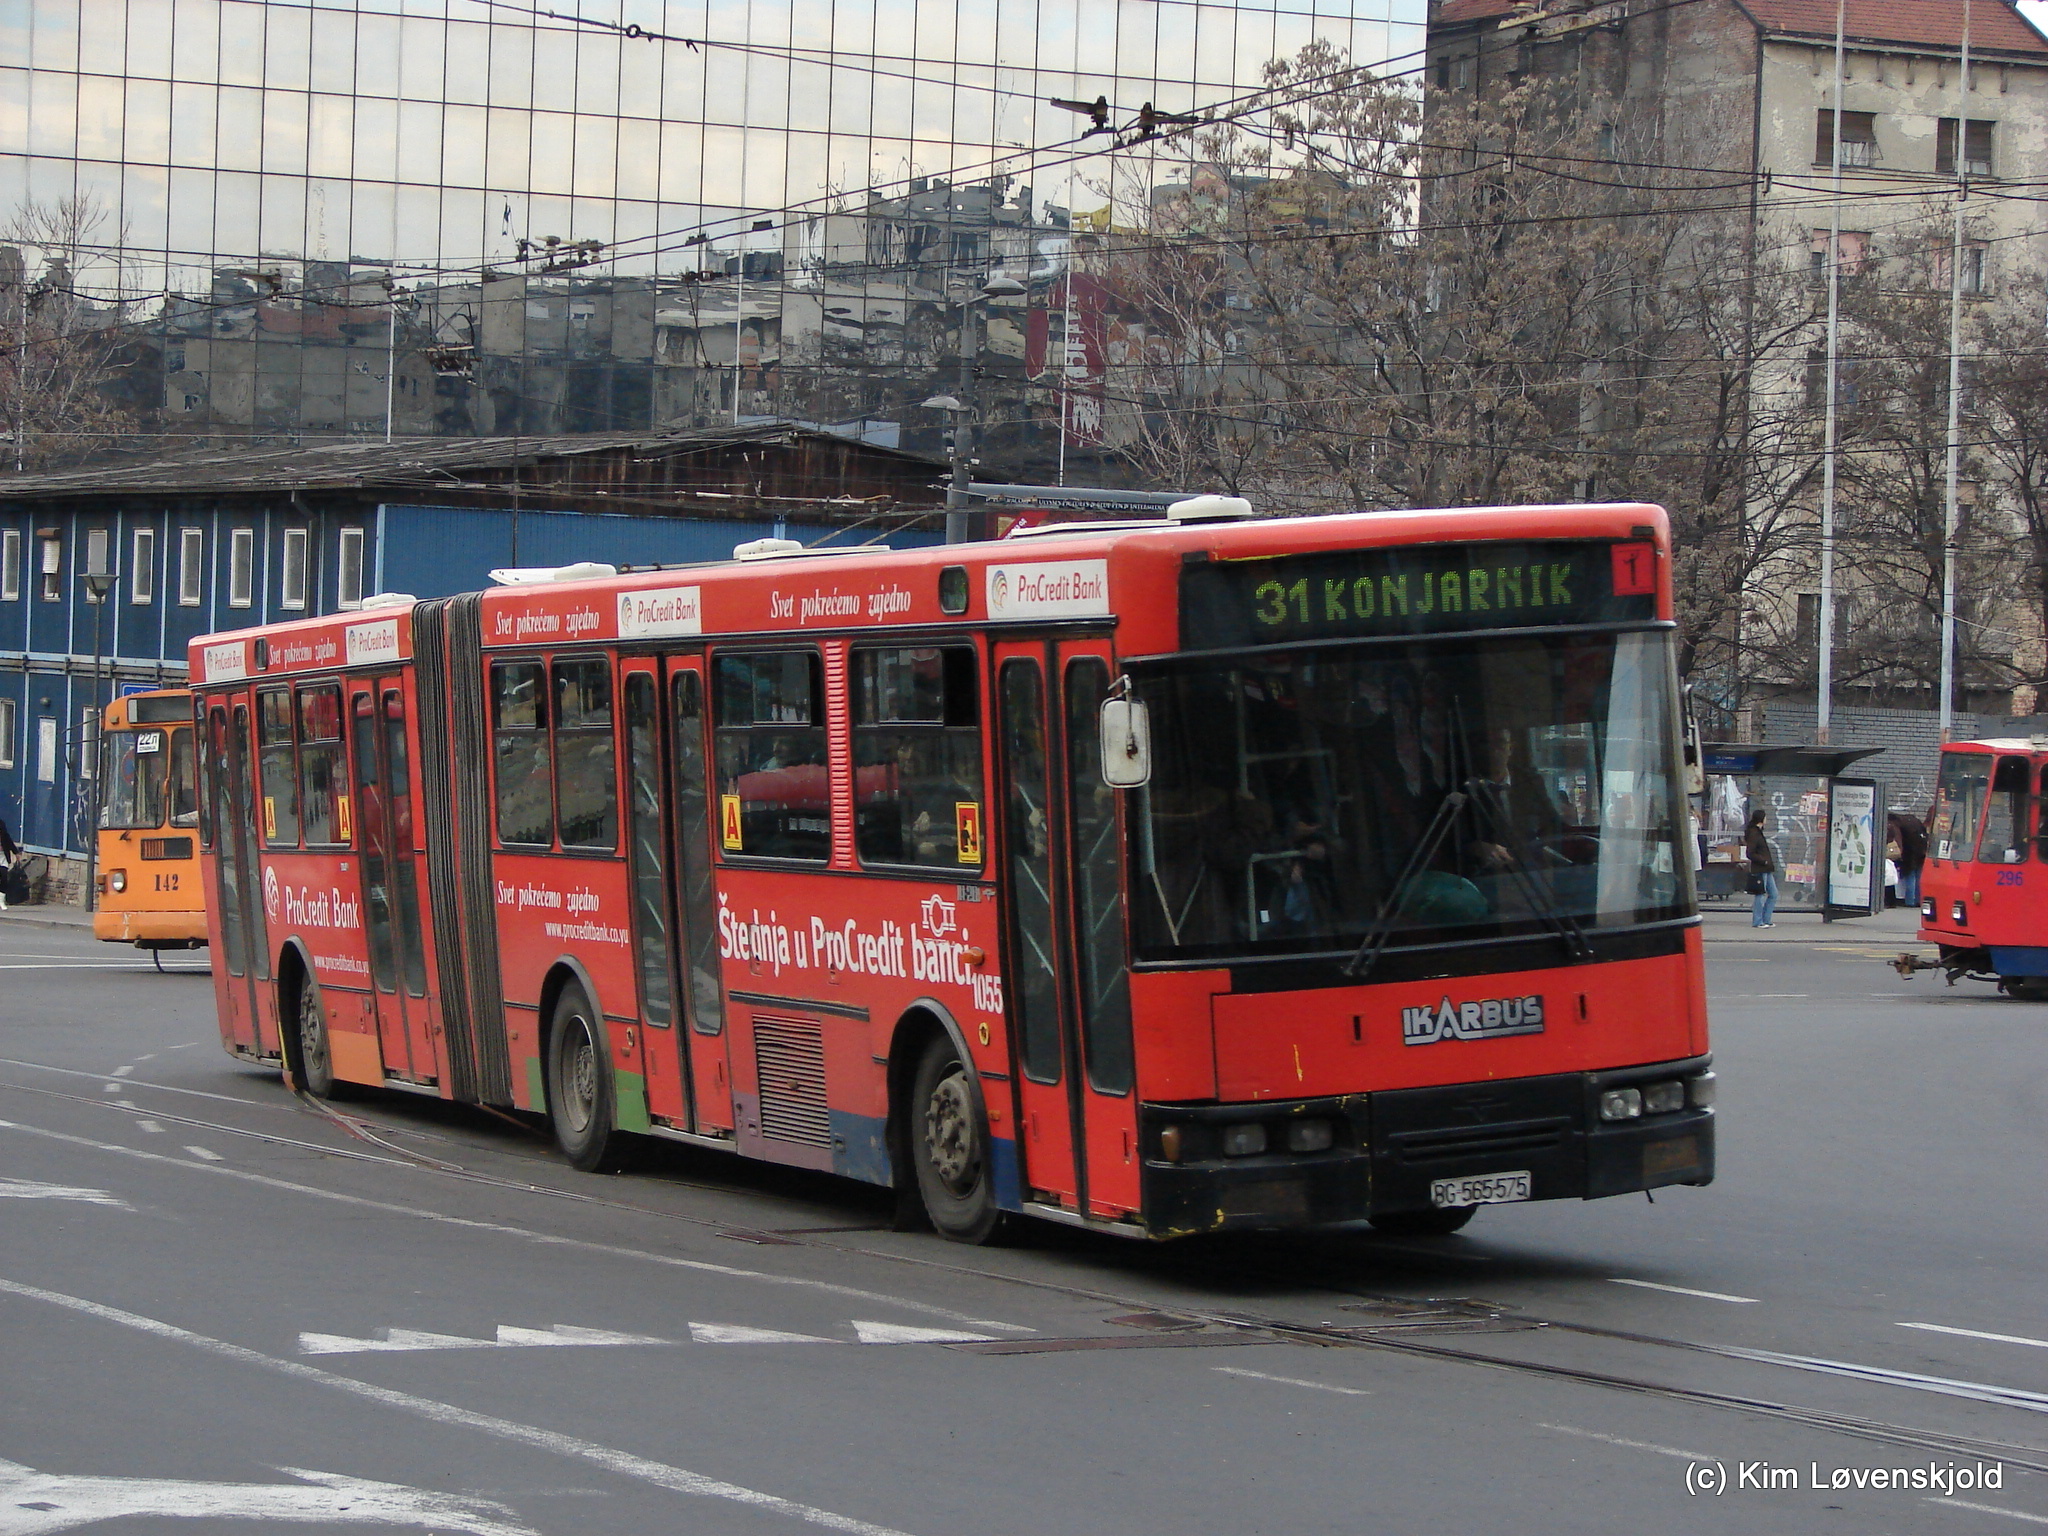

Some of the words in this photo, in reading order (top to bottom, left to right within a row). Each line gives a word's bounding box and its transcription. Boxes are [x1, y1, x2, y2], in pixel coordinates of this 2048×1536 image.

[1017, 574, 1071, 603] ProCredit
[1072, 572, 1102, 600] Bank
[1255, 577, 1309, 625] 31
[1324, 562, 1572, 621] KONJARNIK
[637, 599, 674, 623] ProCredit
[675, 597, 697, 620] Bank
[770, 591, 794, 619] Svet
[800, 587, 860, 625] pokrećemo
[868, 583, 911, 622] zajedno
[495, 611, 513, 636] Svet
[515, 607, 560, 641] pokrećemo
[565, 605, 600, 638] zajedno
[269, 644, 281, 666] Svet
[315, 636, 337, 665] zajedno
[358, 631, 381, 653] ProCredit
[382, 629, 396, 649] Bank
[214, 652, 232, 671] ProCredit
[232, 651, 243, 669] Bank
[267, 802, 275, 831] A
[341, 801, 349, 832] A
[726, 802, 740, 840] A
[154, 873, 179, 892] 142
[1996, 870, 2024, 886] 296
[285, 885, 330, 928] ProCredit
[332, 887, 360, 929] Bank
[497, 880, 515, 905] Svet
[518, 882, 562, 912] pokrećemo
[566, 885, 600, 918] zajedno
[544, 920, 630, 948] www.procreditbank.co.yu
[718, 891, 791, 978] Štednja
[793, 930, 809, 969] u
[810, 915, 907, 978] ProCredit
[910, 922, 972, 986] banci
[971, 972, 1004, 1014] 1055
[1402, 995, 1544, 1045] IKARBUS
